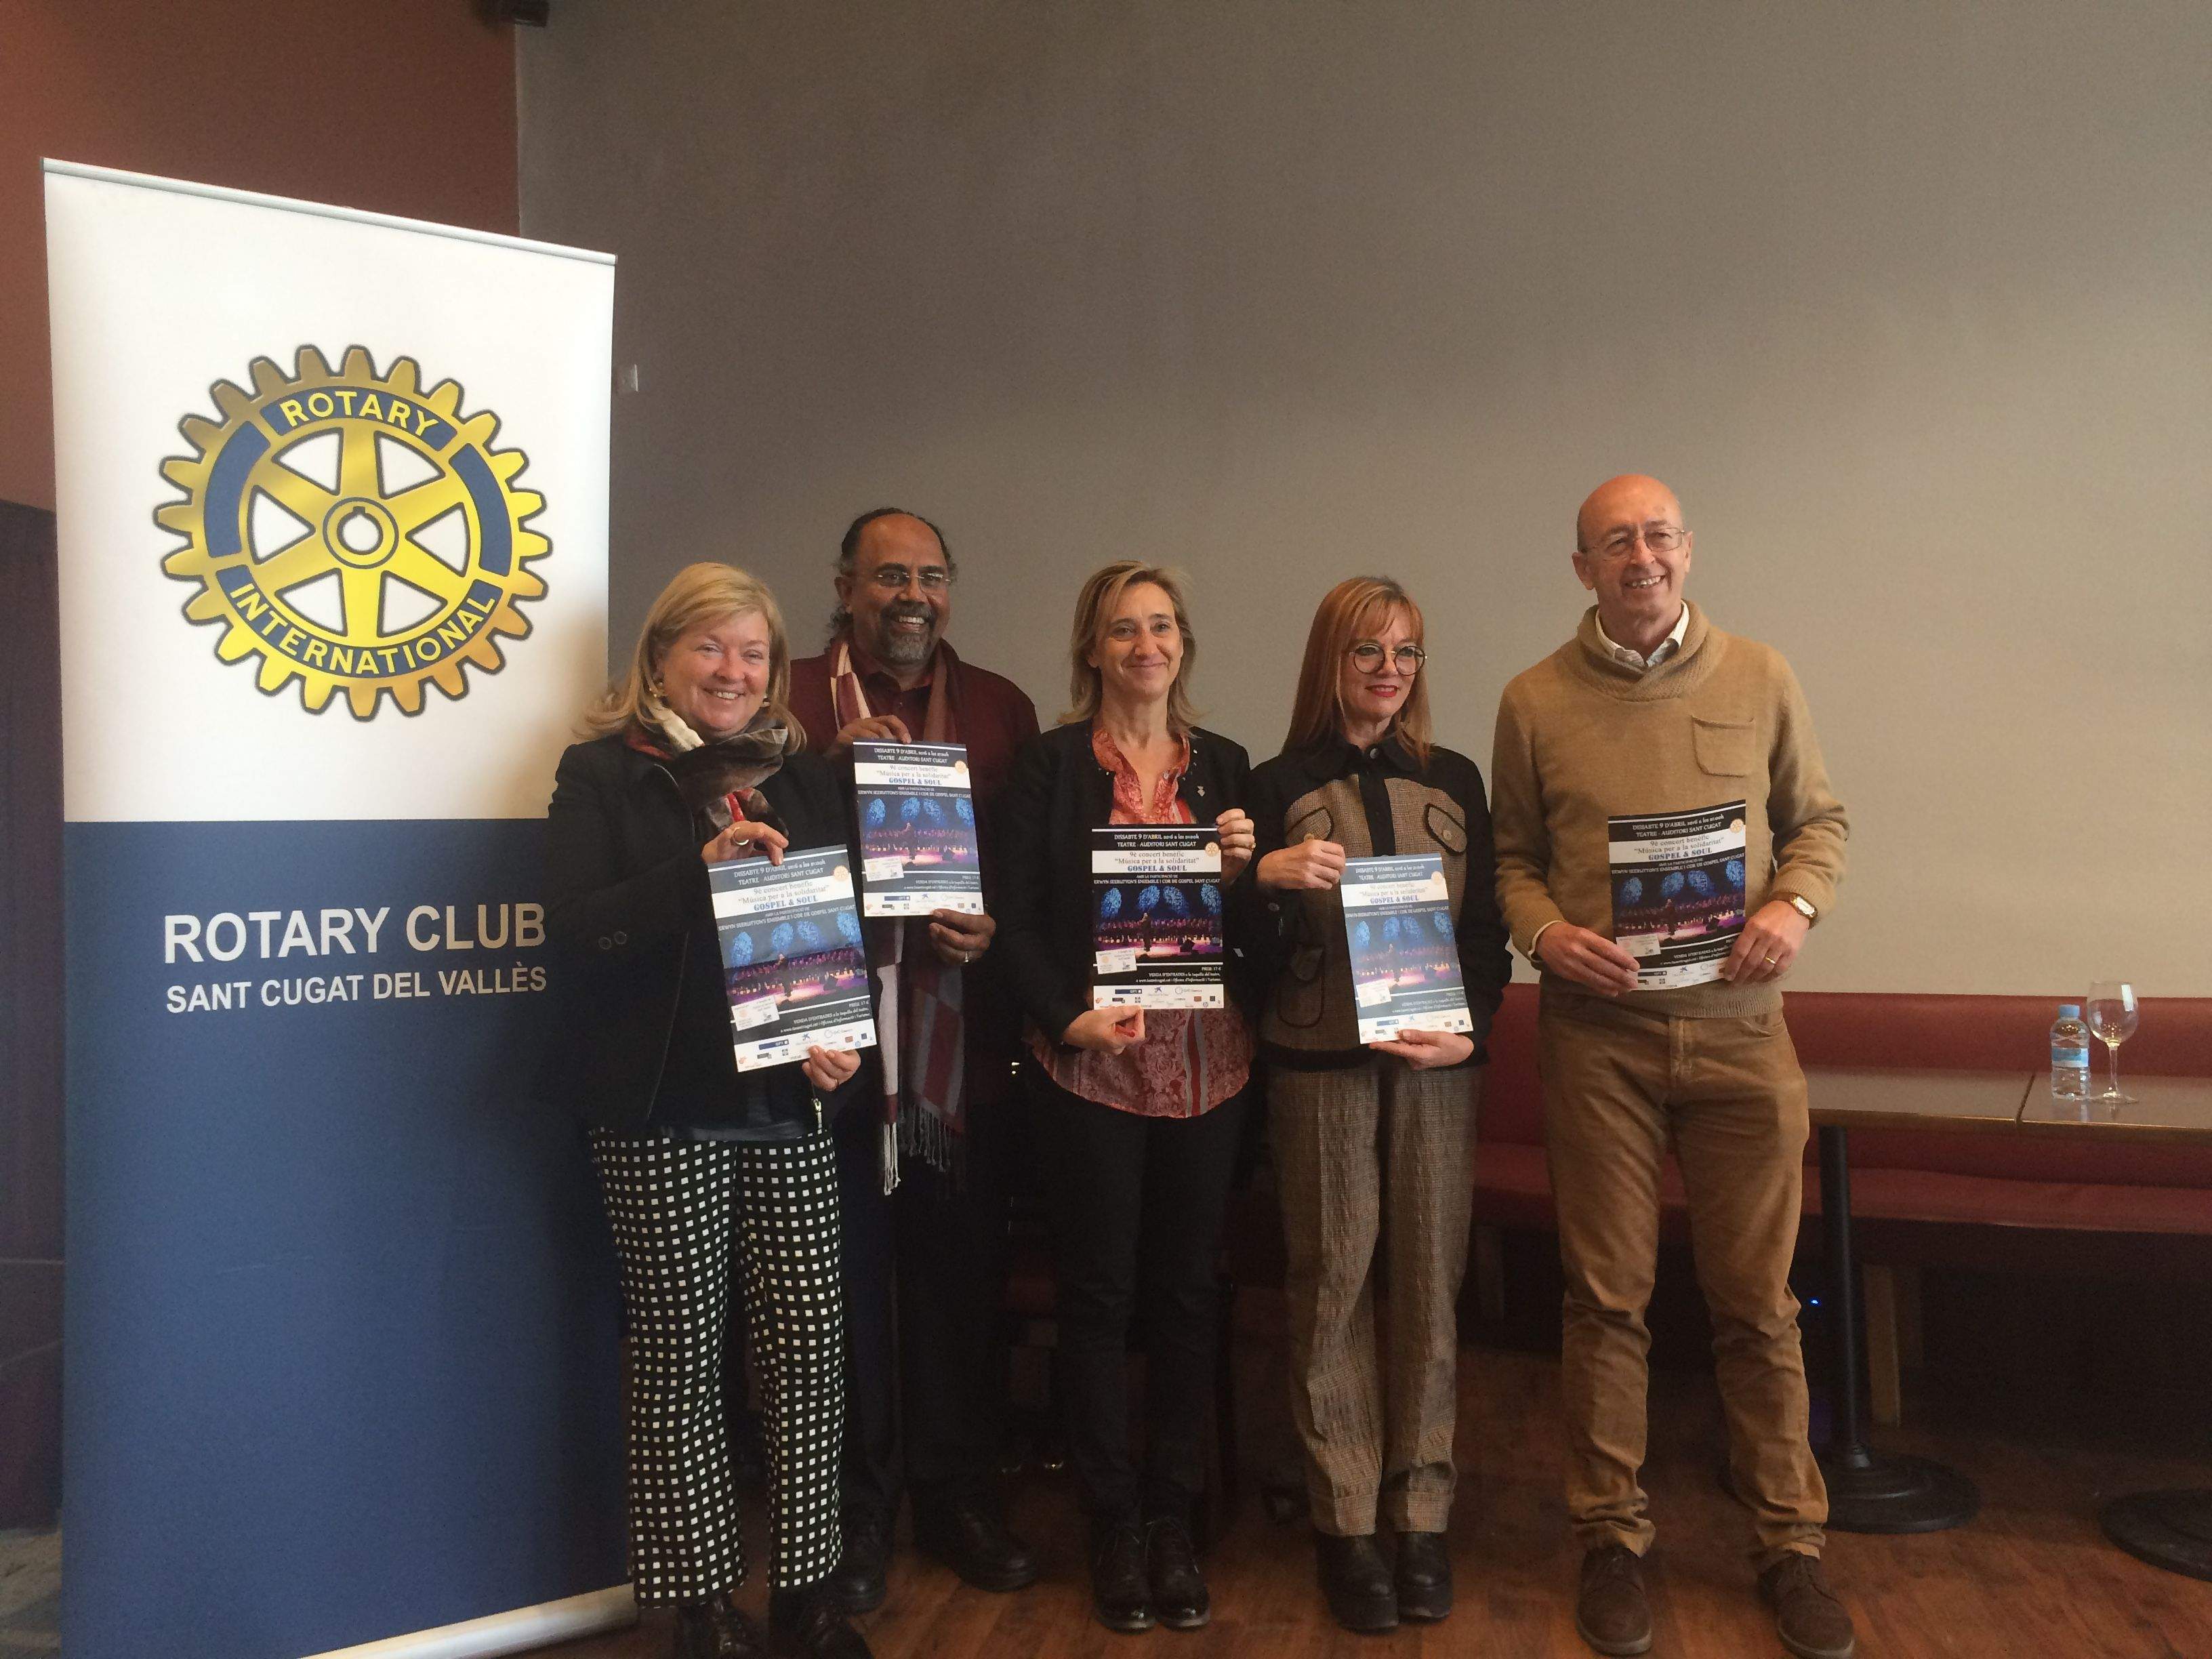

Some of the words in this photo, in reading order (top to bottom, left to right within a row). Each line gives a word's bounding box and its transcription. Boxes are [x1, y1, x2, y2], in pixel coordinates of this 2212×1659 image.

[280, 390, 438, 437] ROTARY
[230, 583, 495, 674] INTERNATIONAL
[1704, 822, 1721, 830] CUGAT
[1649, 853, 1681, 861] GOSPEL
[1692, 847, 1712, 857] SOUL
[165, 907, 390, 964] ROTARY
[407, 903, 546, 951] CLUB
[167, 981, 251, 1013] SANT
[261, 975, 363, 1006] CUGAT
[373, 971, 430, 1000] DEL
[438, 962, 547, 995] VALLÈS
